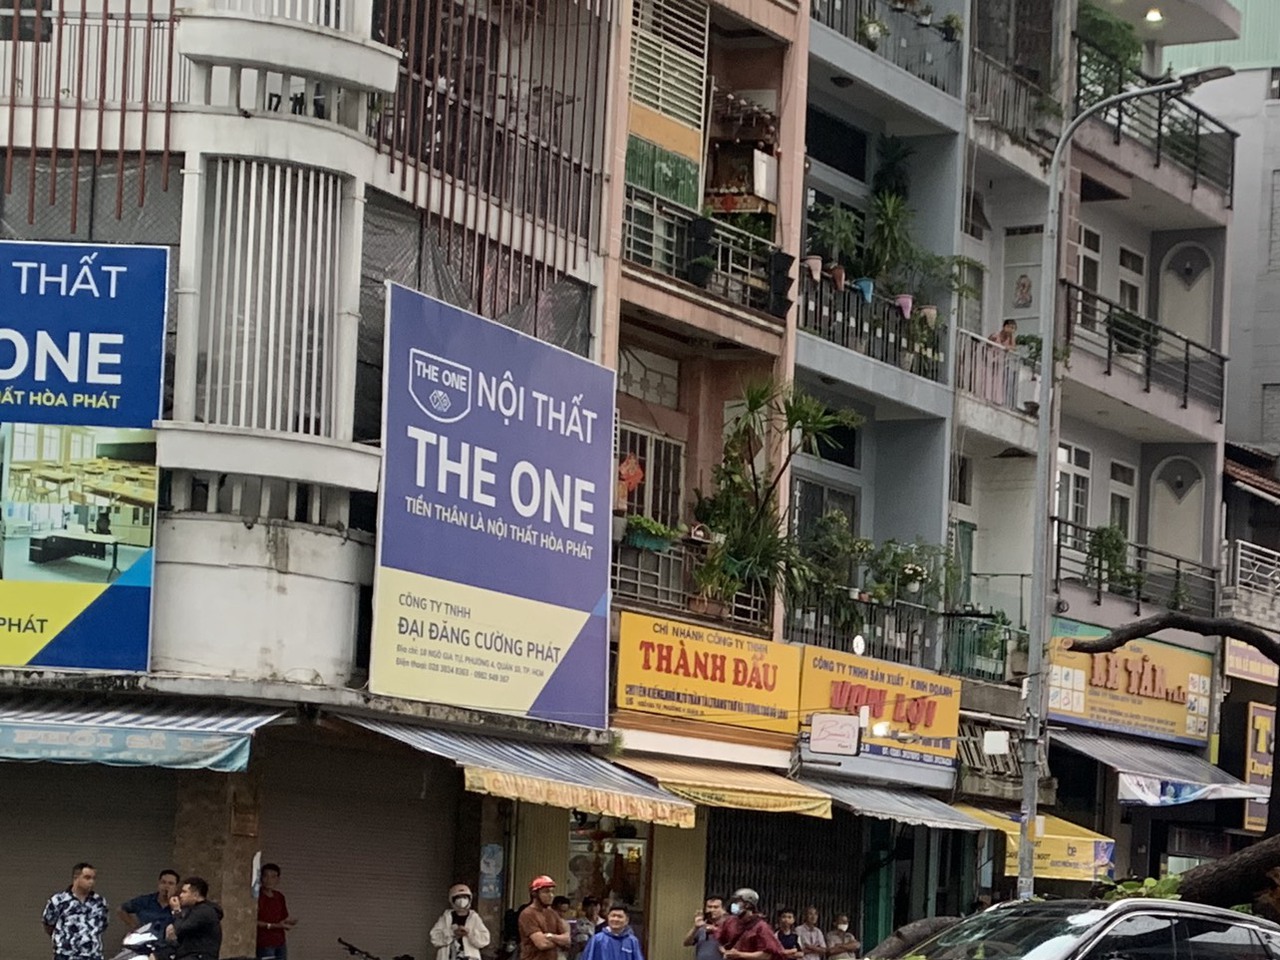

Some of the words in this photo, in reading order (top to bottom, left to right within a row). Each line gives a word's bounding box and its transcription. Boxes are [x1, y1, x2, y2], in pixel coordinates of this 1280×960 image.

[12, 252, 127, 298] THẤT
[0, 328, 124, 385] ONE
[415, 360, 439, 383] THE
[442, 370, 467, 392] ONE
[0, 385, 25, 405] ẤT
[29, 388, 68, 407] HÒA
[72, 391, 120, 409] PHÁT
[477, 370, 524, 426] NỘI
[532, 393, 597, 444] THẤT
[407, 425, 498, 507] THE
[510, 460, 595, 535] ONE
[435, 505, 468, 528] THÂN
[470, 511, 485, 533] LÀ
[487, 517, 508, 541] NỘI
[509, 524, 538, 547] THẤT
[540, 532, 564, 553] HÒA
[566, 541, 593, 560] PHÁT
[399, 592, 427, 610] CÔNG
[429, 600, 443, 614] TY
[444, 603, 471, 619] TNHH
[398, 617, 424, 642] ĐẠI
[428, 620, 470, 647] ĐĂNG
[475, 631, 523, 656] CƯỜNG
[527, 641, 561, 664] PHÁT
[672, 626, 704, 642] NHÁNH
[706, 632, 733, 648] CÔNG
[735, 638, 744, 650] TY
[640, 639, 726, 684] THÀNH
[813, 656, 834, 672] CÔNG
[837, 662, 845, 674] TY
[848, 665, 868, 679] TNHH
